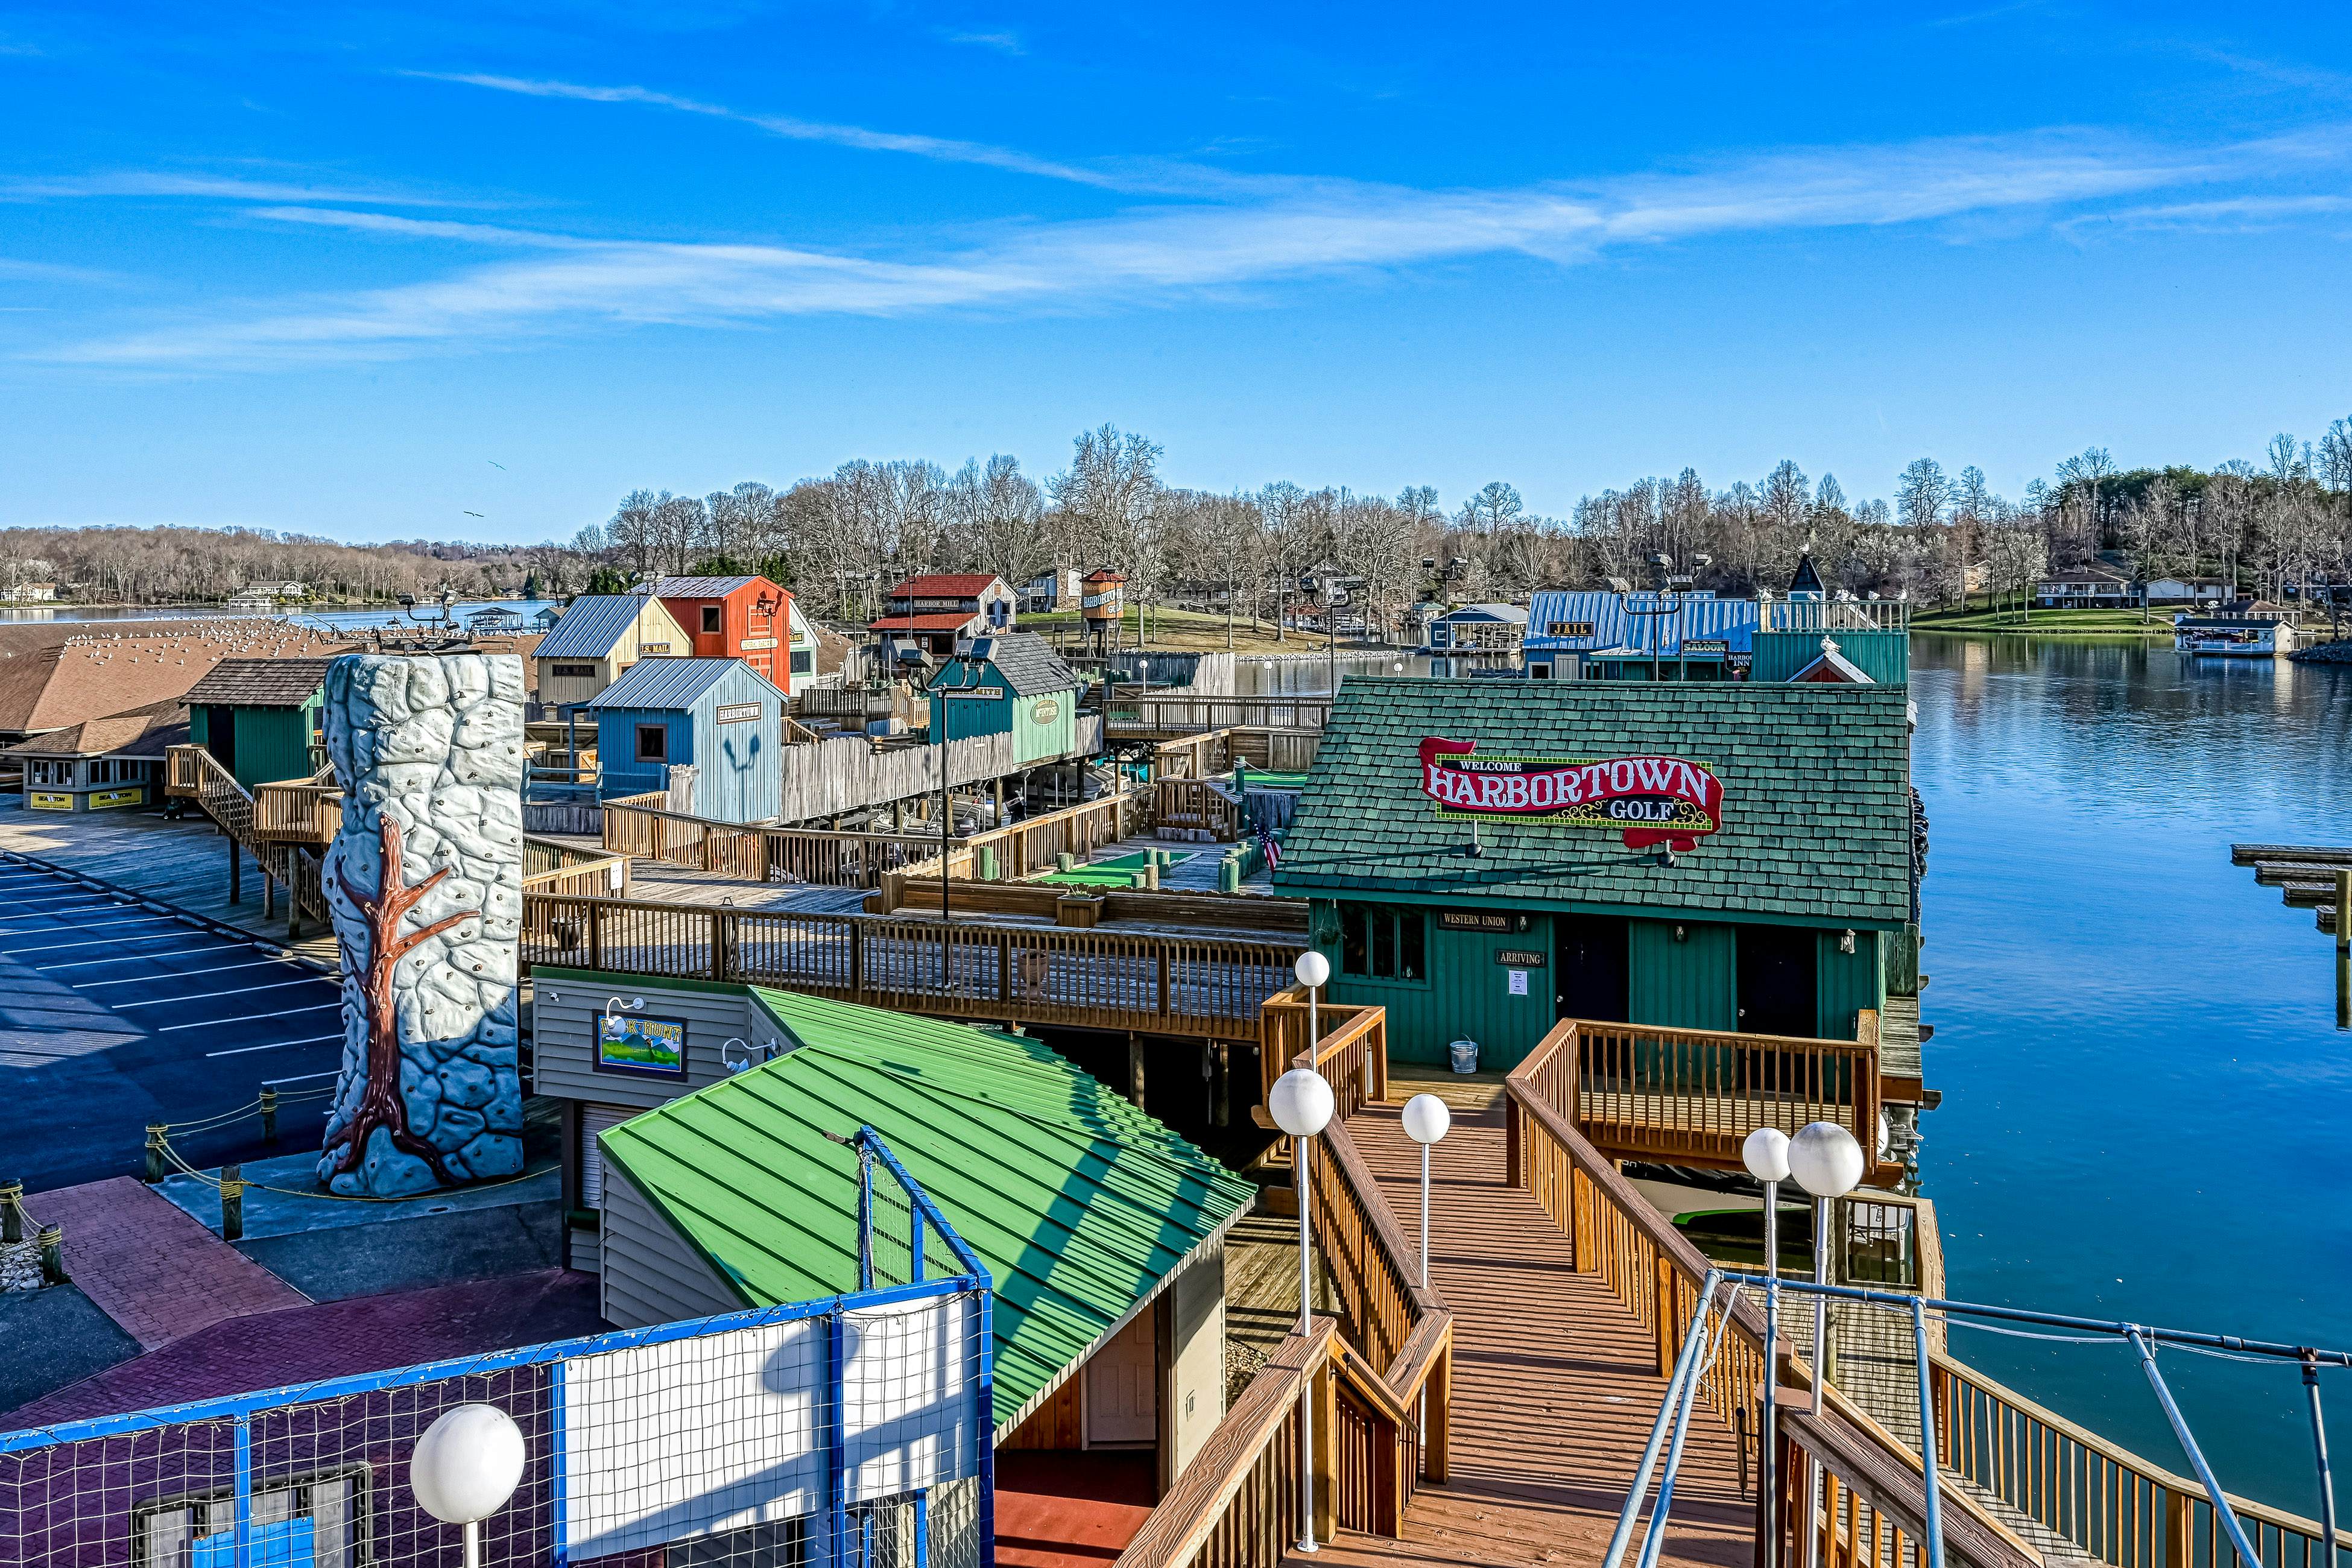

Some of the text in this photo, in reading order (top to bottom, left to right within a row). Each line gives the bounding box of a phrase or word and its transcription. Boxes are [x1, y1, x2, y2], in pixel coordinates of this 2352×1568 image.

[1554, 624, 1587, 634] JAIL
[653, 645, 669, 653] MAIL
[719, 706, 759, 721] HARBORTOWN
[1459, 760, 1522, 772] WELCOME
[1427, 759, 1710, 808] HARBORTOWN
[1610, 800, 1674, 820] GOLF
[1444, 913, 1506, 926] WESTERN UNION
[1500, 952, 1540, 964] ARRIVING
[599, 1019, 682, 1042] DK HUNT
